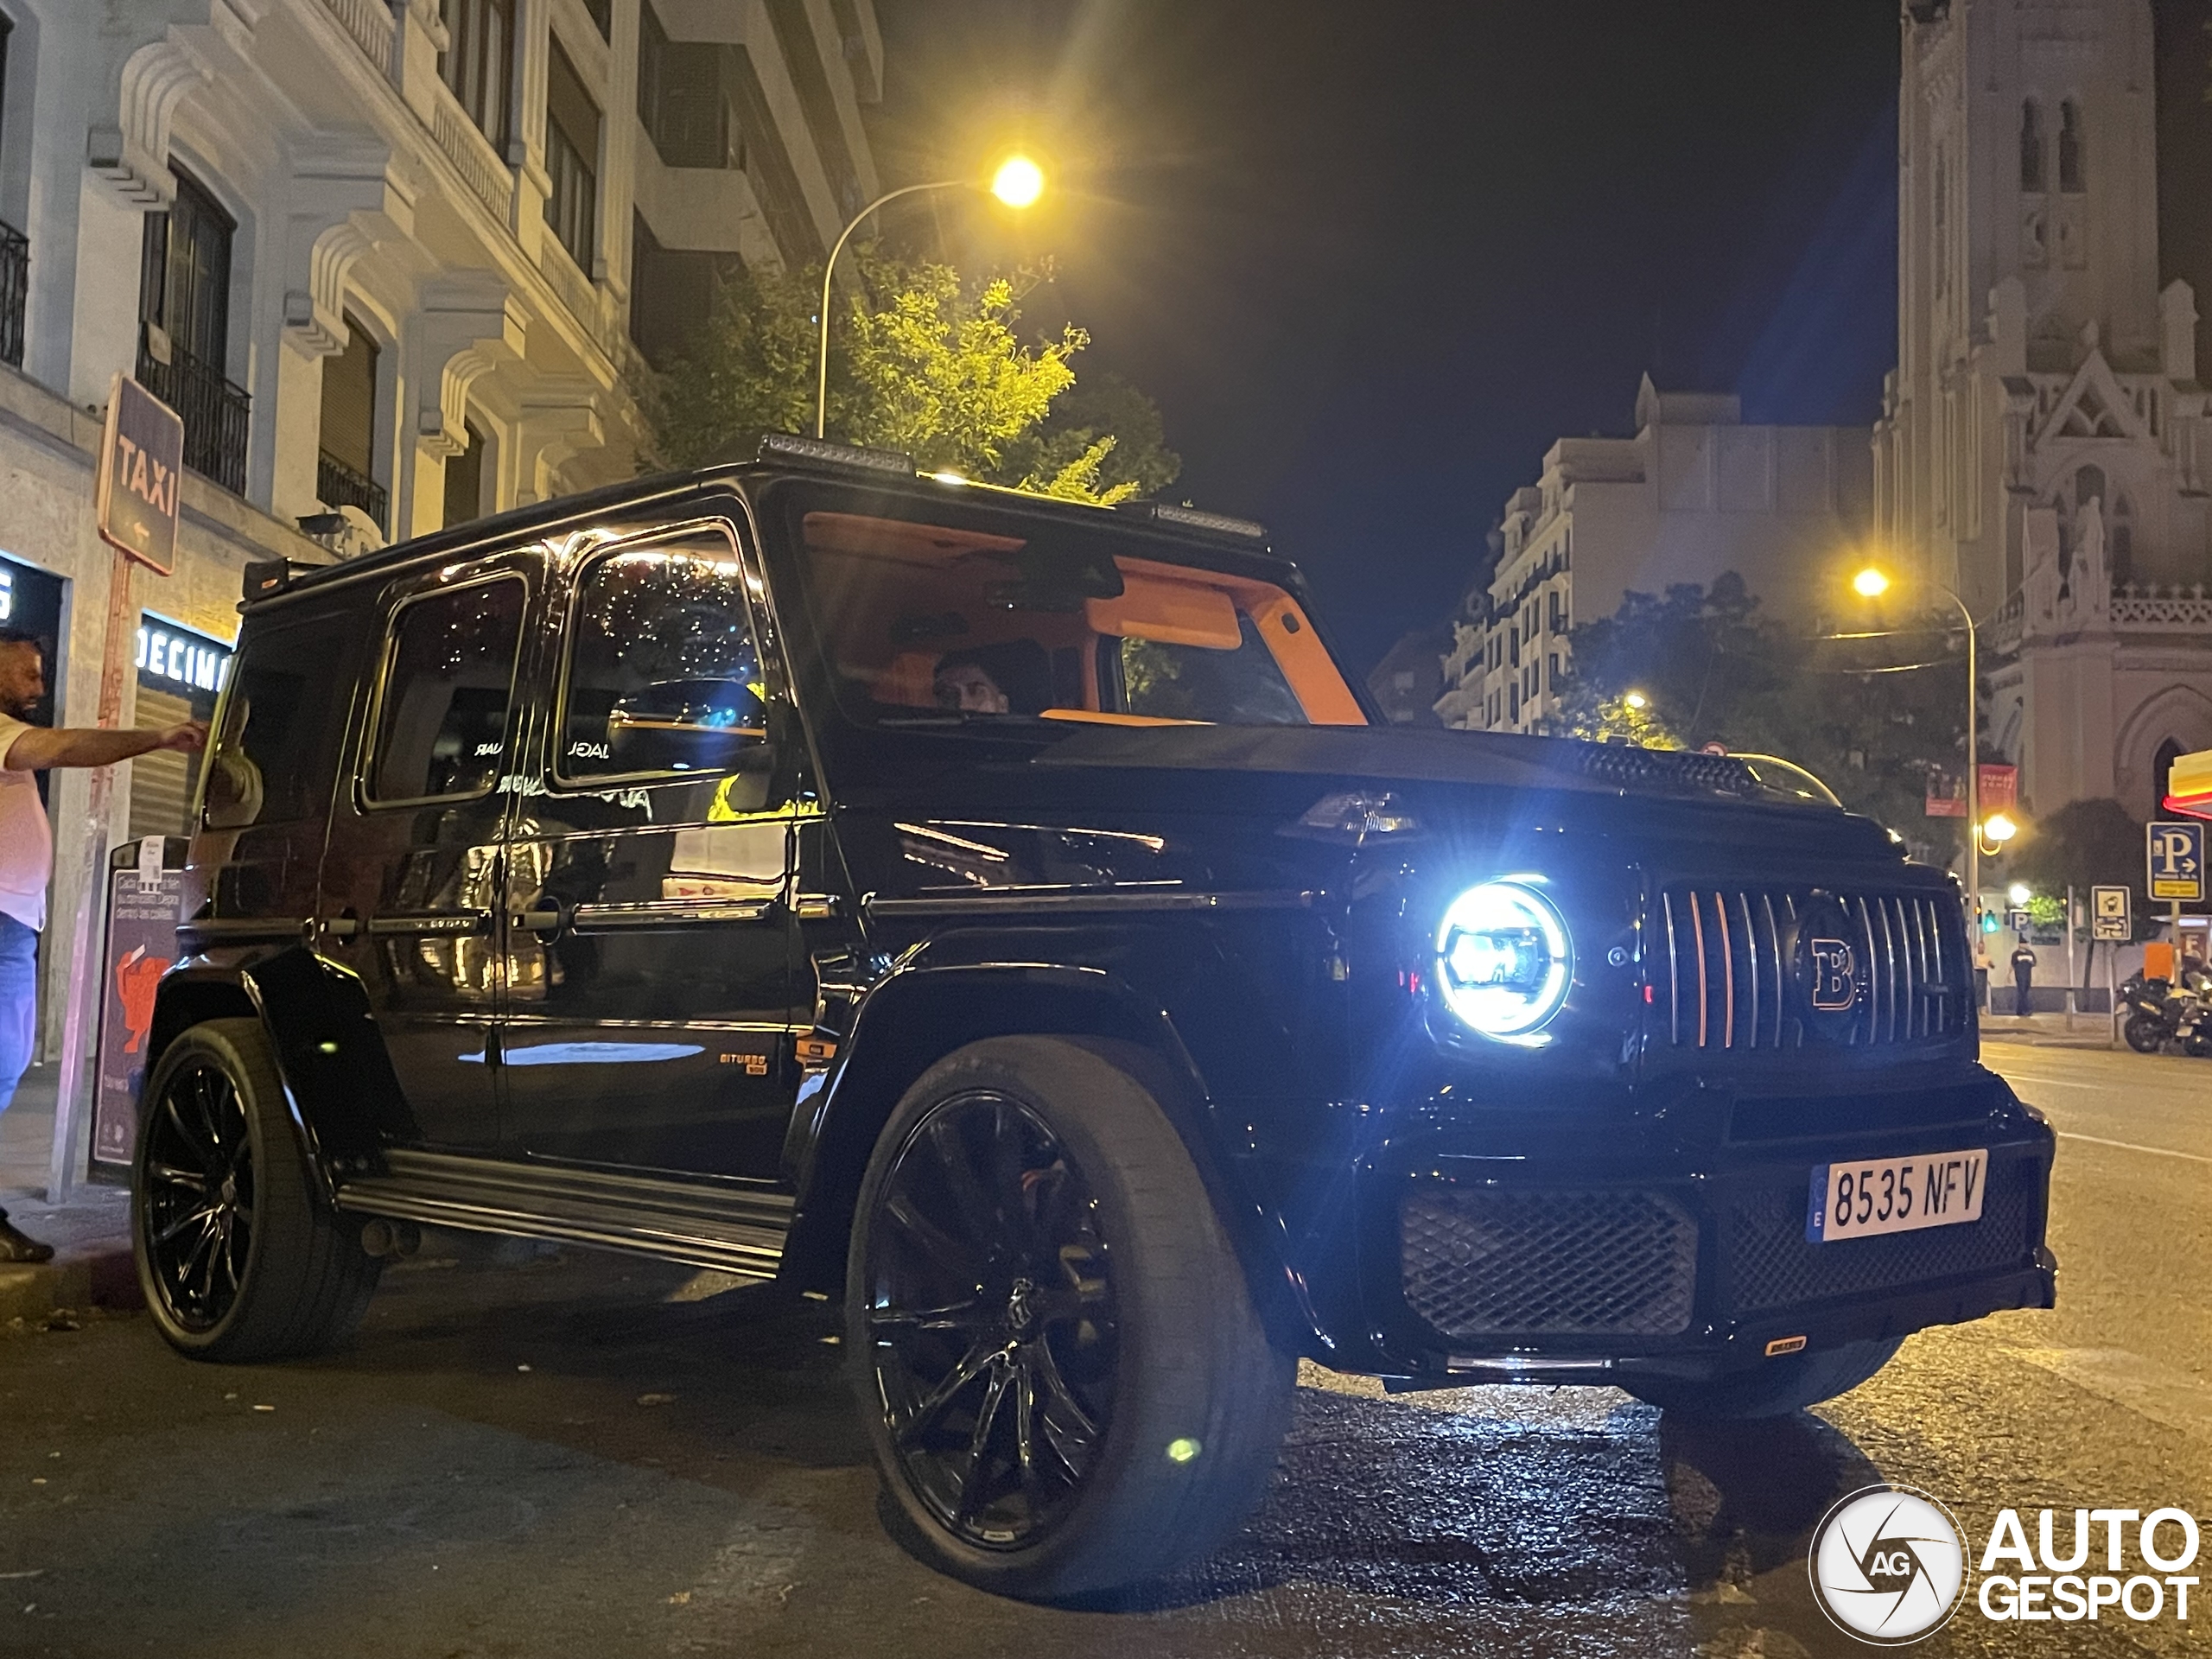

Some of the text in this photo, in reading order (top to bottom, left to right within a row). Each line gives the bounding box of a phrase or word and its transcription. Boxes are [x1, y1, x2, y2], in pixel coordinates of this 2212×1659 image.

[118, 434, 175, 517] TAXI
[2162, 833, 2192, 873] P
[2015, 913, 2028, 930] P
[1835, 1159, 1980, 1226] 8535 NFV
[1814, 1211, 1822, 1227] E
